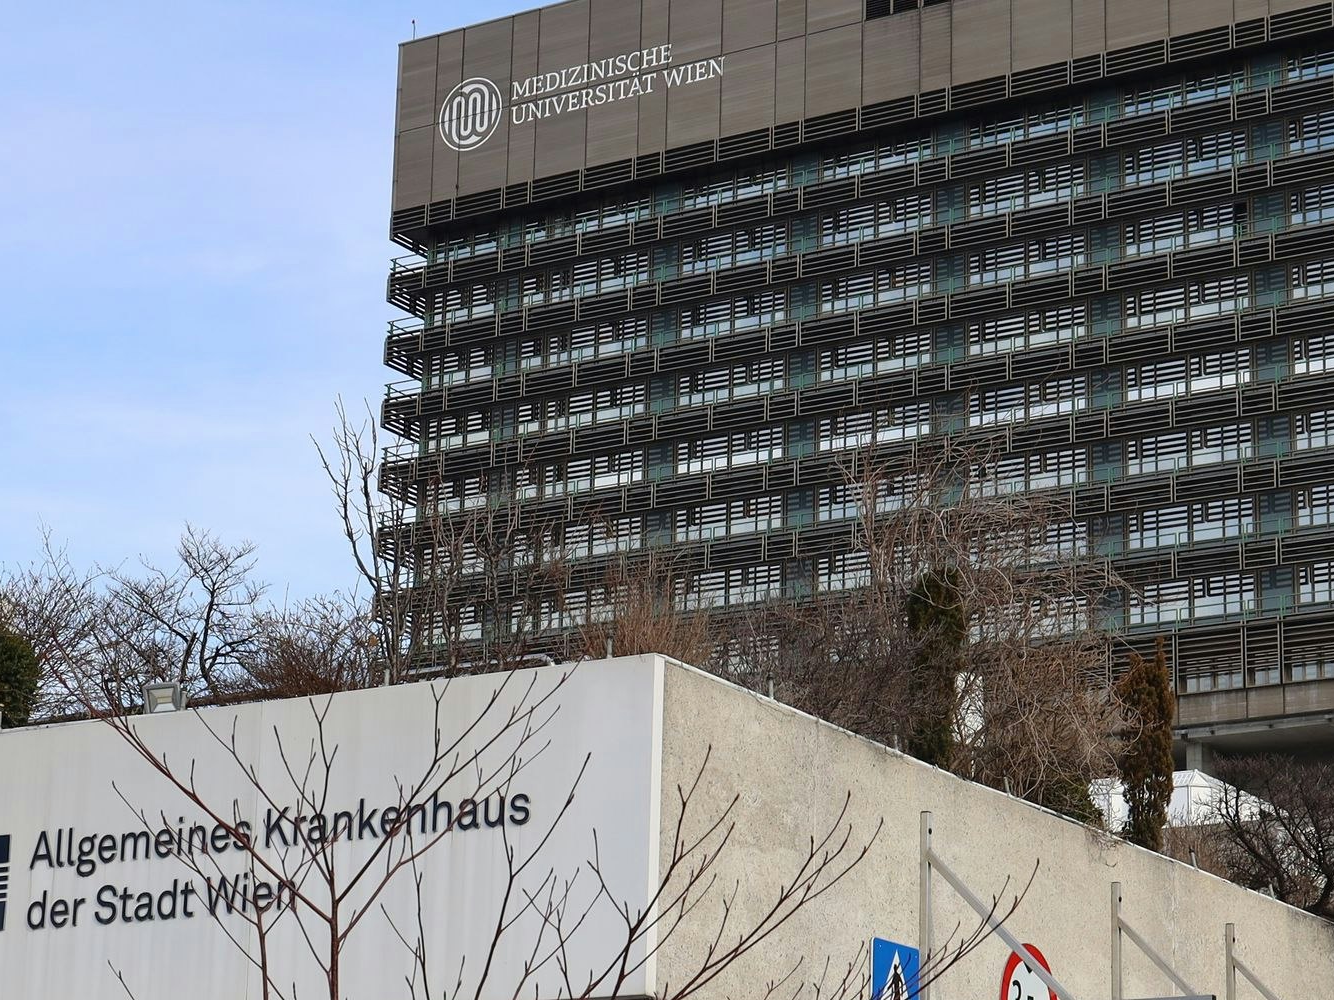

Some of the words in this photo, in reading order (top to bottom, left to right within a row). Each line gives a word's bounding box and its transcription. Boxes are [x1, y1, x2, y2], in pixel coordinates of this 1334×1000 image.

[511, 43, 672, 100] MEDIZINISCHE
[511, 71, 656, 125] UNIVERSITÄT
[663, 56, 725, 89] WIEN
[29, 815, 252, 877] Allgemeines
[264, 790, 532, 848] Krankenhaus
[26, 888, 87, 930] der
[94, 879, 195, 927] Stadt
[206, 874, 298, 918] Wien
